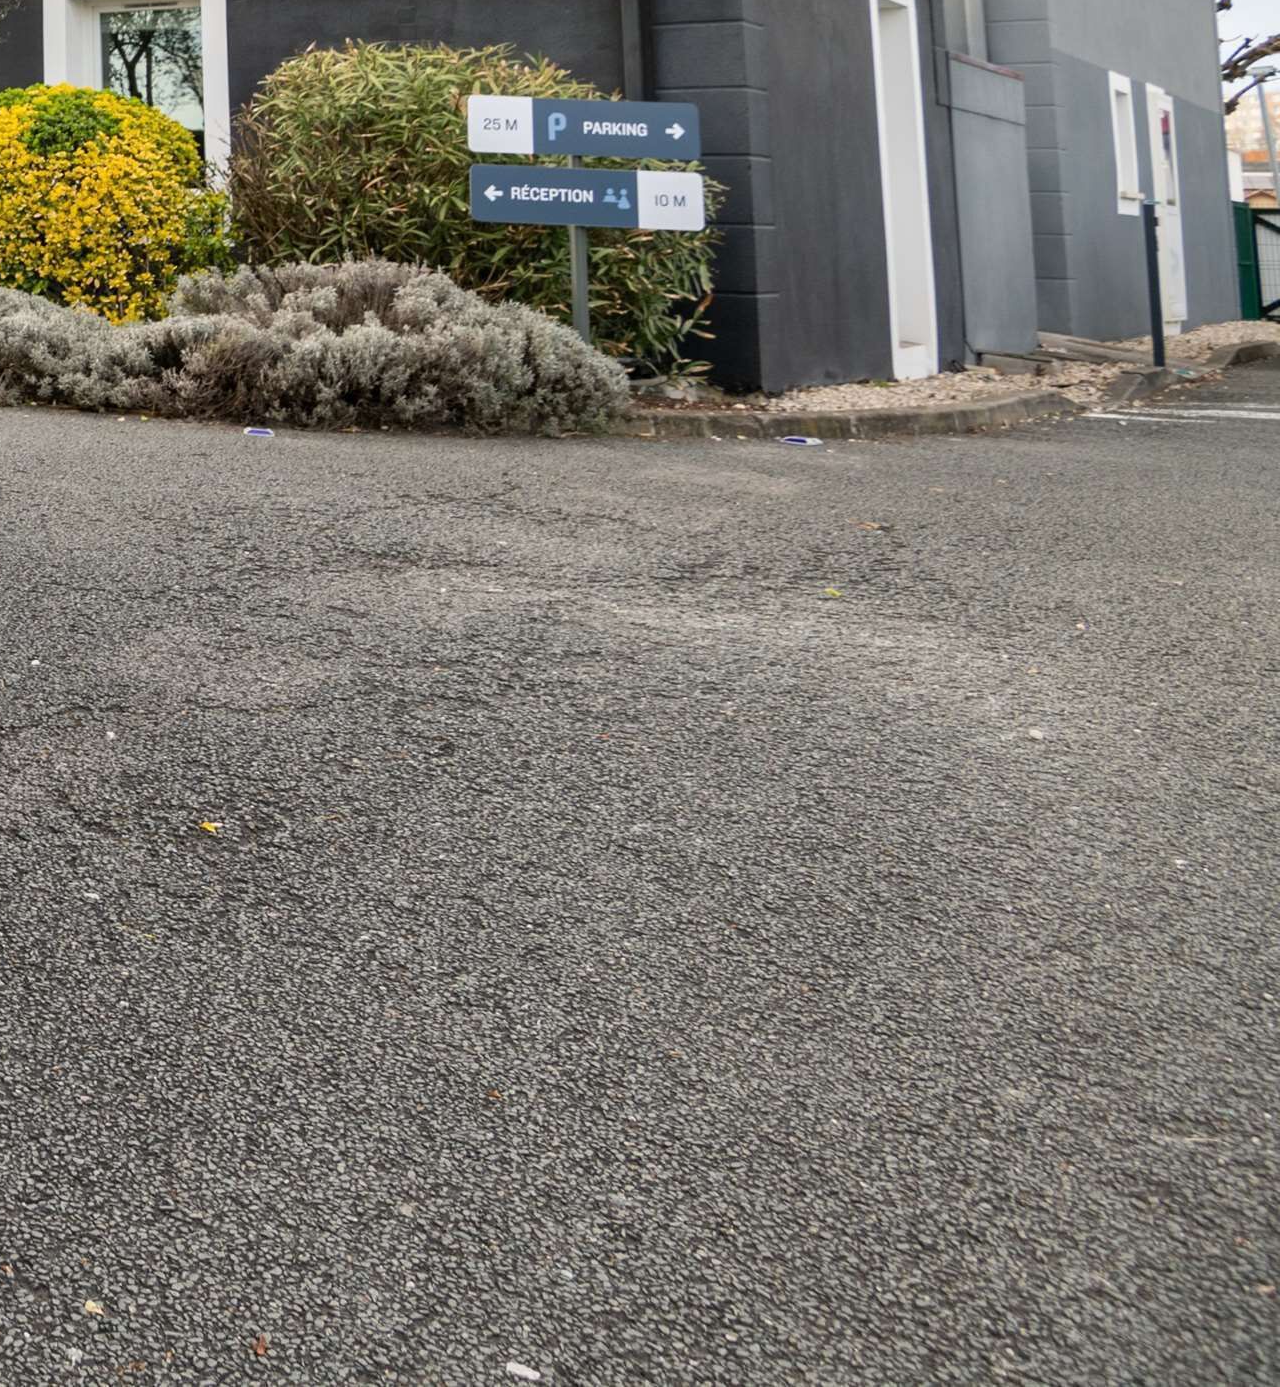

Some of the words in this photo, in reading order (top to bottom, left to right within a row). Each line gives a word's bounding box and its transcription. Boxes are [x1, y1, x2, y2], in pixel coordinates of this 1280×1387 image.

[483, 117, 501, 131] 25
[505, 119, 519, 131] M
[547, 112, 567, 141] P
[582, 120, 649, 137] PARKING
[510, 183, 594, 204] RÉCEPTION
[673, 194, 687, 207] M
